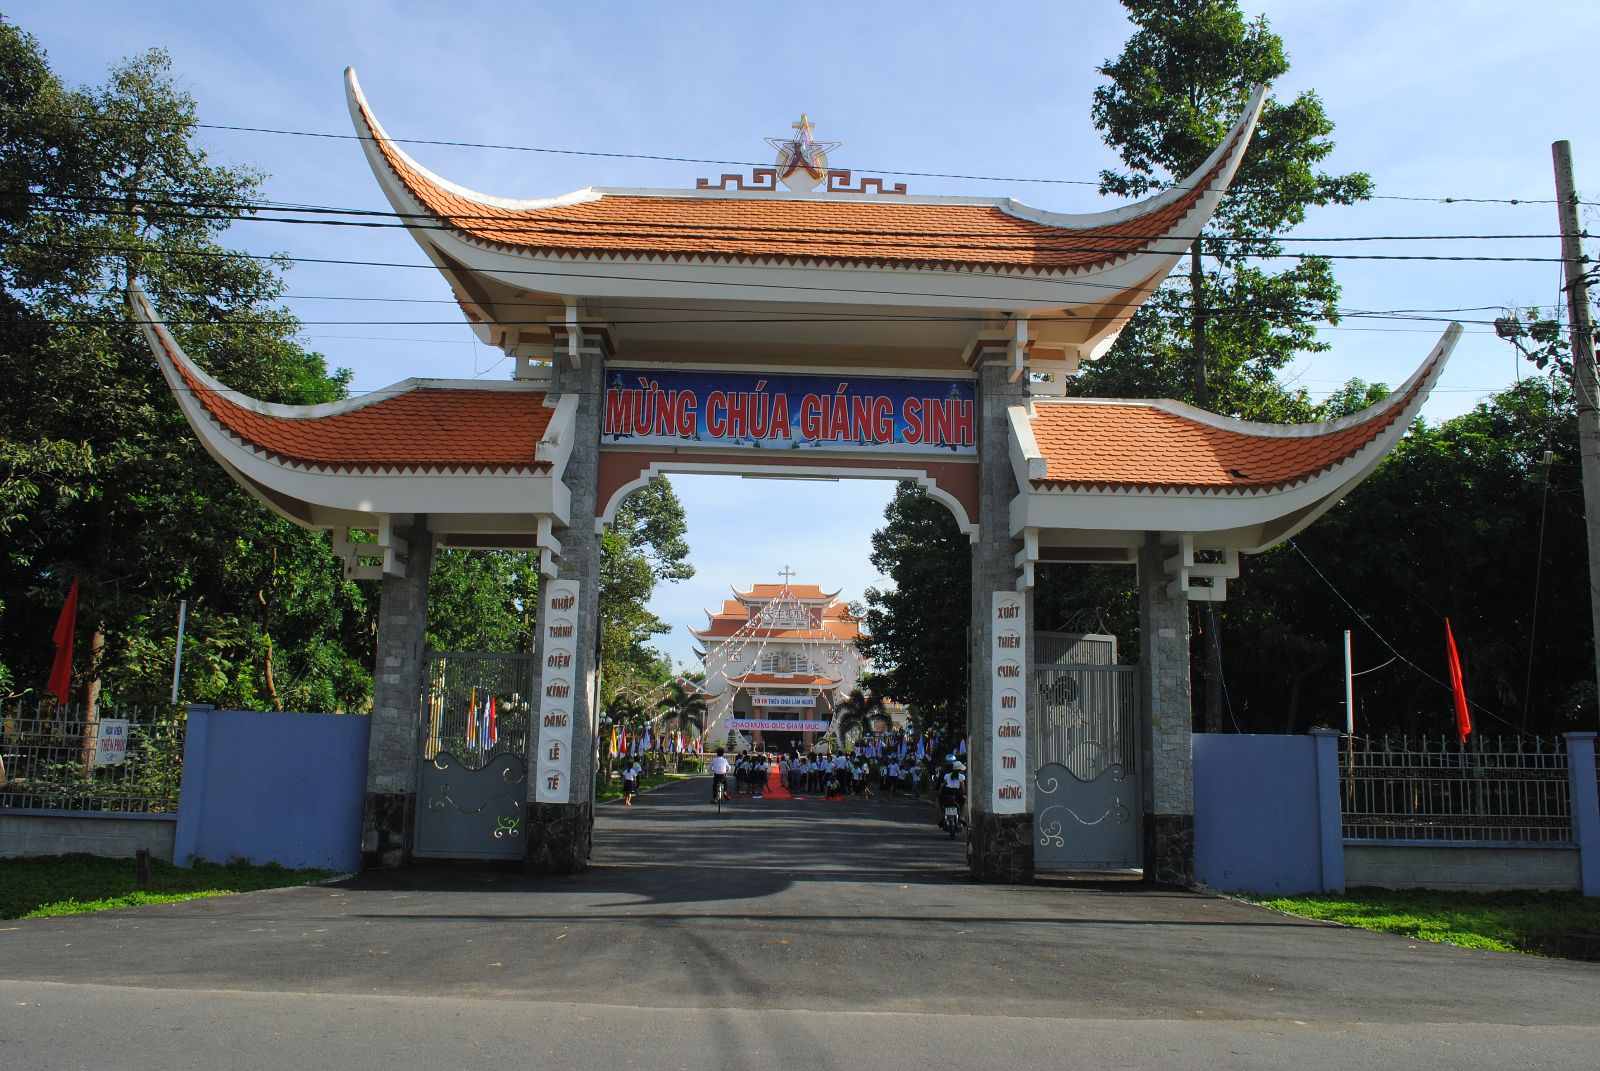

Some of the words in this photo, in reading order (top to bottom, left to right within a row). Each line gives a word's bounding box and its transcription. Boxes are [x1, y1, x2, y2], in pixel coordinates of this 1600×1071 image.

[604, 377, 698, 437] MỪNG
[706, 380, 792, 440] CHÚA
[800, 383, 894, 443] GIÁNG
[902, 397, 974, 445] SINH
[551, 596, 575, 611] NHẬP
[997, 602, 1020, 618] XUẤT
[549, 624, 573, 638] THÁNH
[997, 633, 1021, 648] THIÊN
[547, 653, 571, 669] ĐIỆN
[997, 665, 1020, 678] CUNG
[546, 683, 570, 698] KÍNH
[1001, 696, 1017, 708] VUI
[998, 722, 1021, 737] GIẢNG
[549, 743, 560, 760] LỄ
[1002, 756, 1017, 768] TIN
[547, 773, 560, 790] TẾ
[998, 785, 1022, 799] MỪNG
